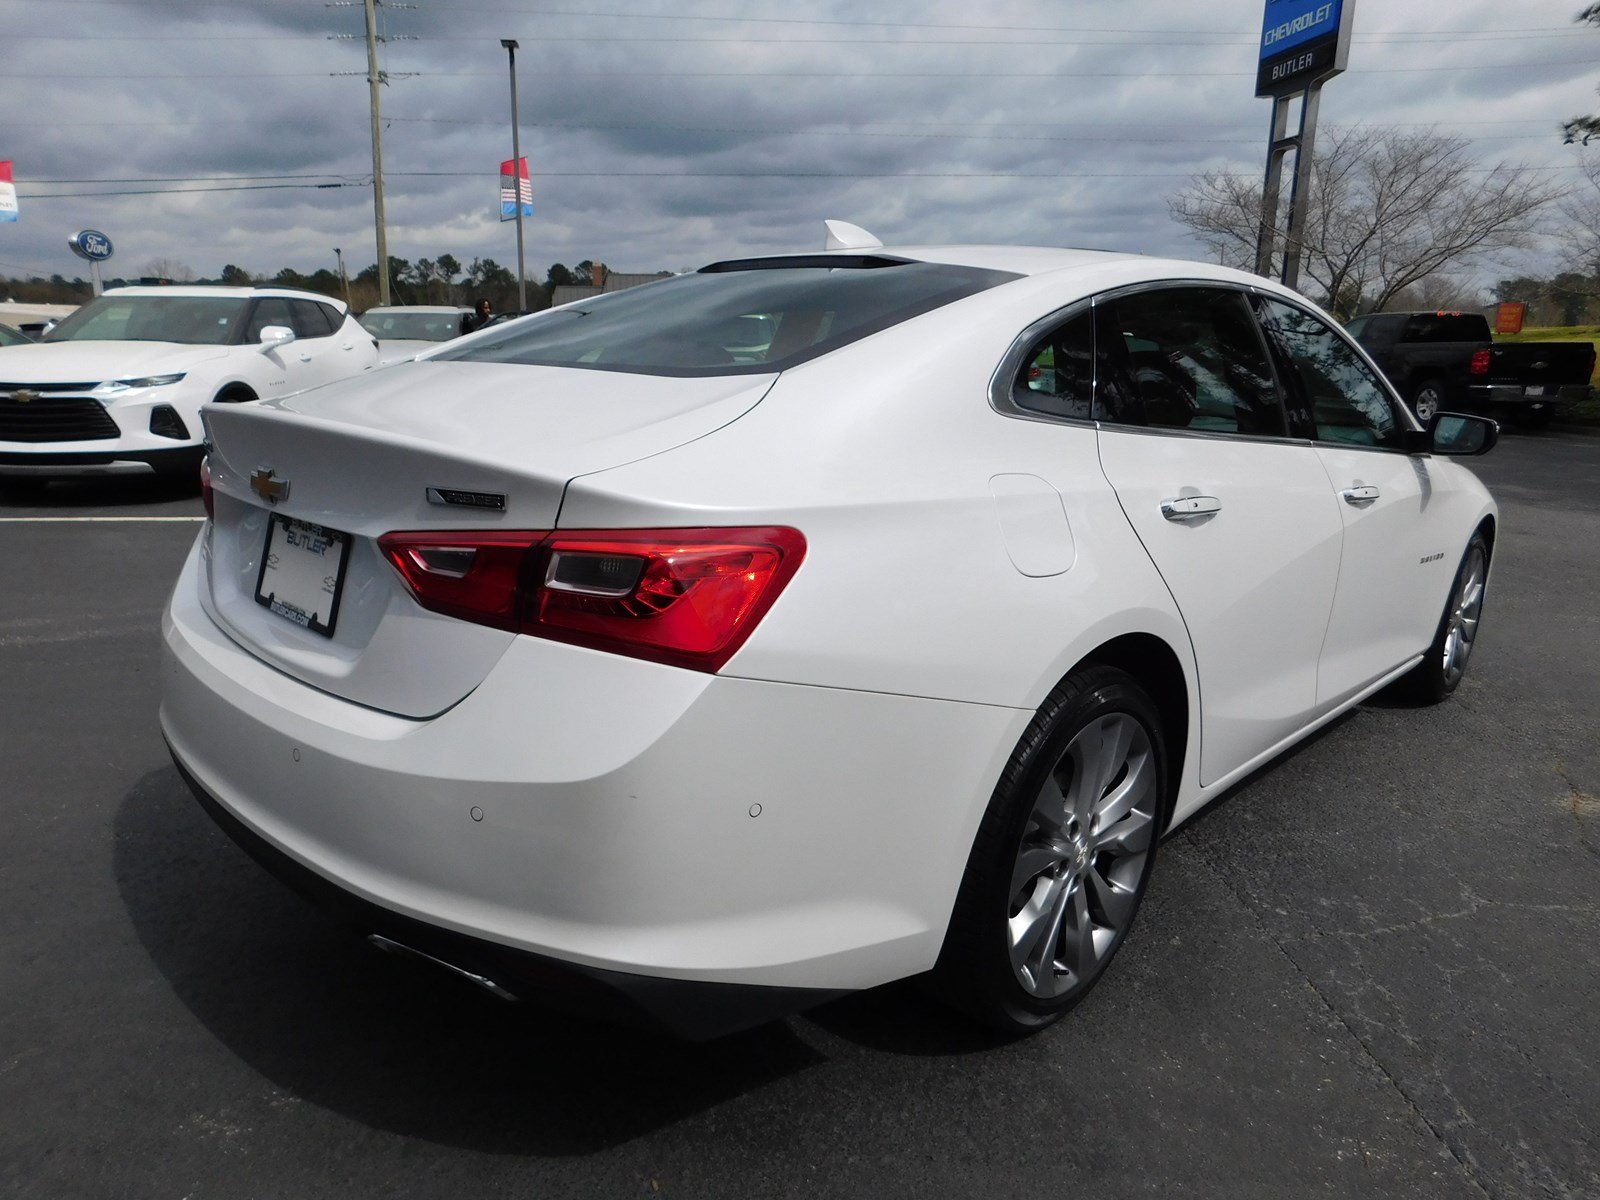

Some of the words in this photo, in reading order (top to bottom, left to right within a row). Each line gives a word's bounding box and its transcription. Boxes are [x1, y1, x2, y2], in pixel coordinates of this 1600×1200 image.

[1264, 3, 1332, 47] CHEVROLET
[1271, 52, 1313, 80] BUTLER
[86, 234, 109, 256] Ford
[286, 530, 328, 556] BUTLER
